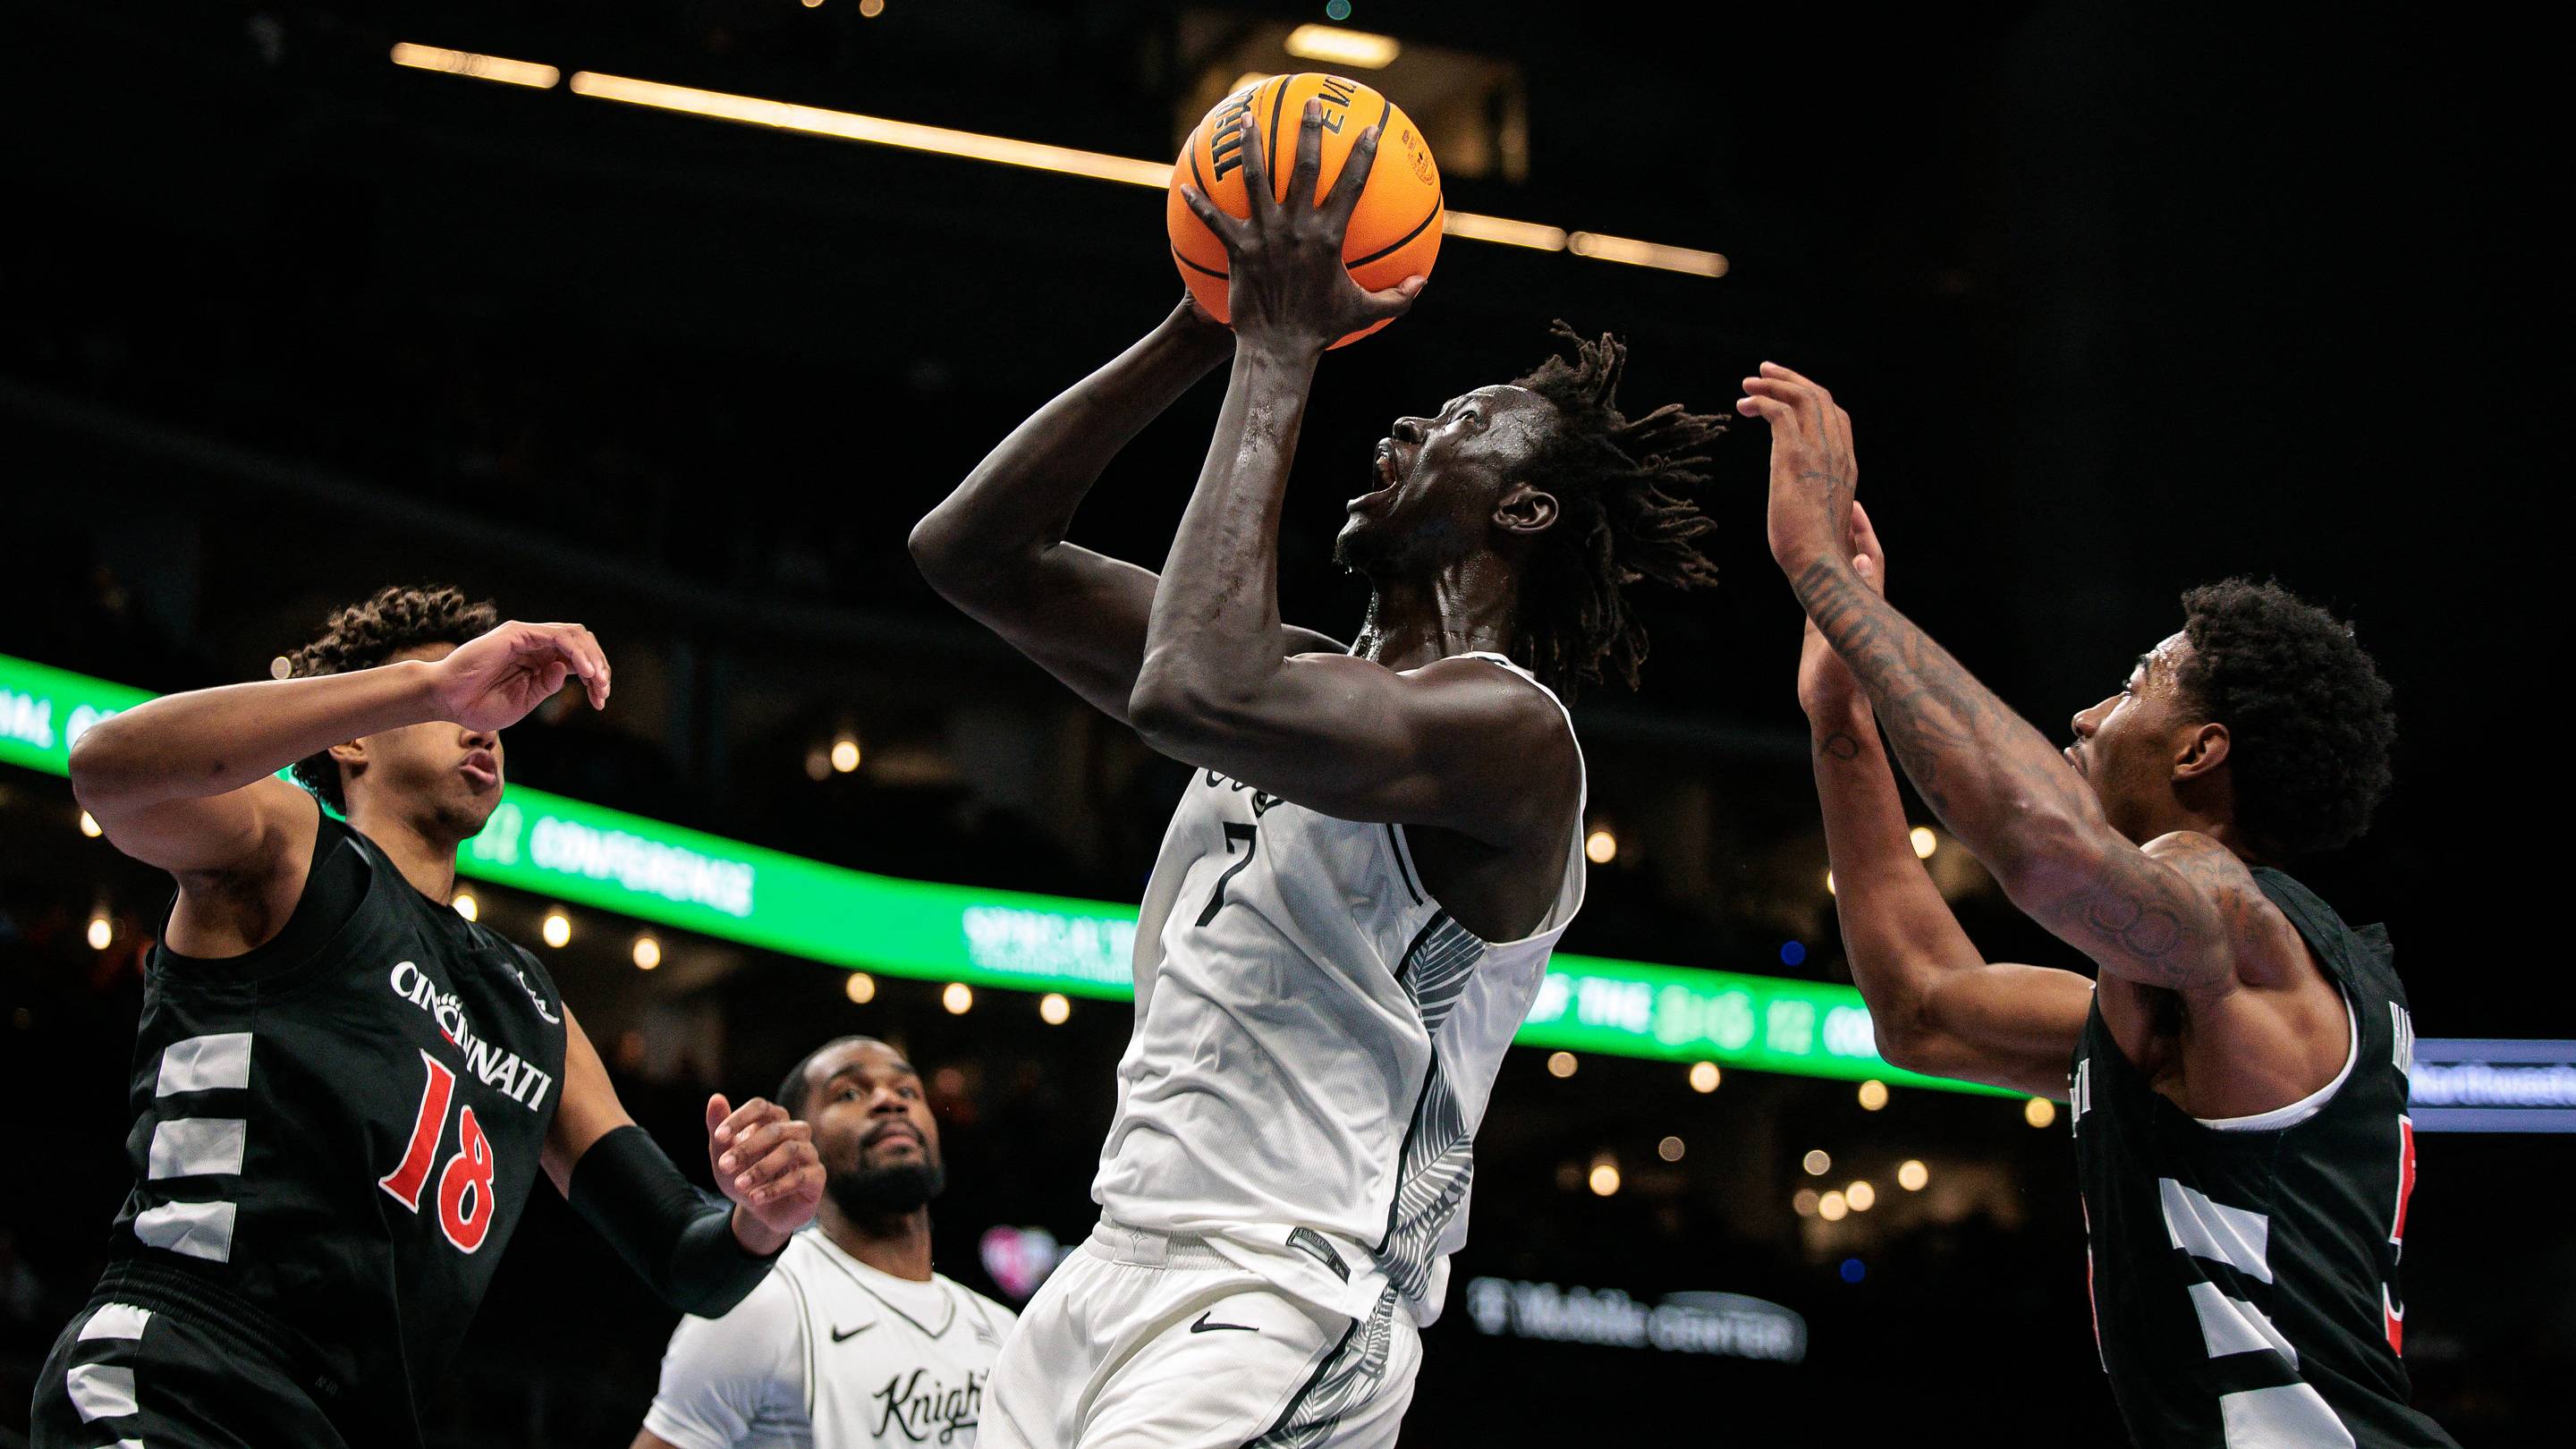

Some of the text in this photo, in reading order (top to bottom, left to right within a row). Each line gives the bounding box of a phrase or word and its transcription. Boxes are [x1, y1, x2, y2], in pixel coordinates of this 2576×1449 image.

[1195, 821, 1258, 927] 7
[391, 961, 552, 1112] CINCINNATI
[378, 1047, 495, 1255] 18
[870, 1368, 990, 1445] Knigh
